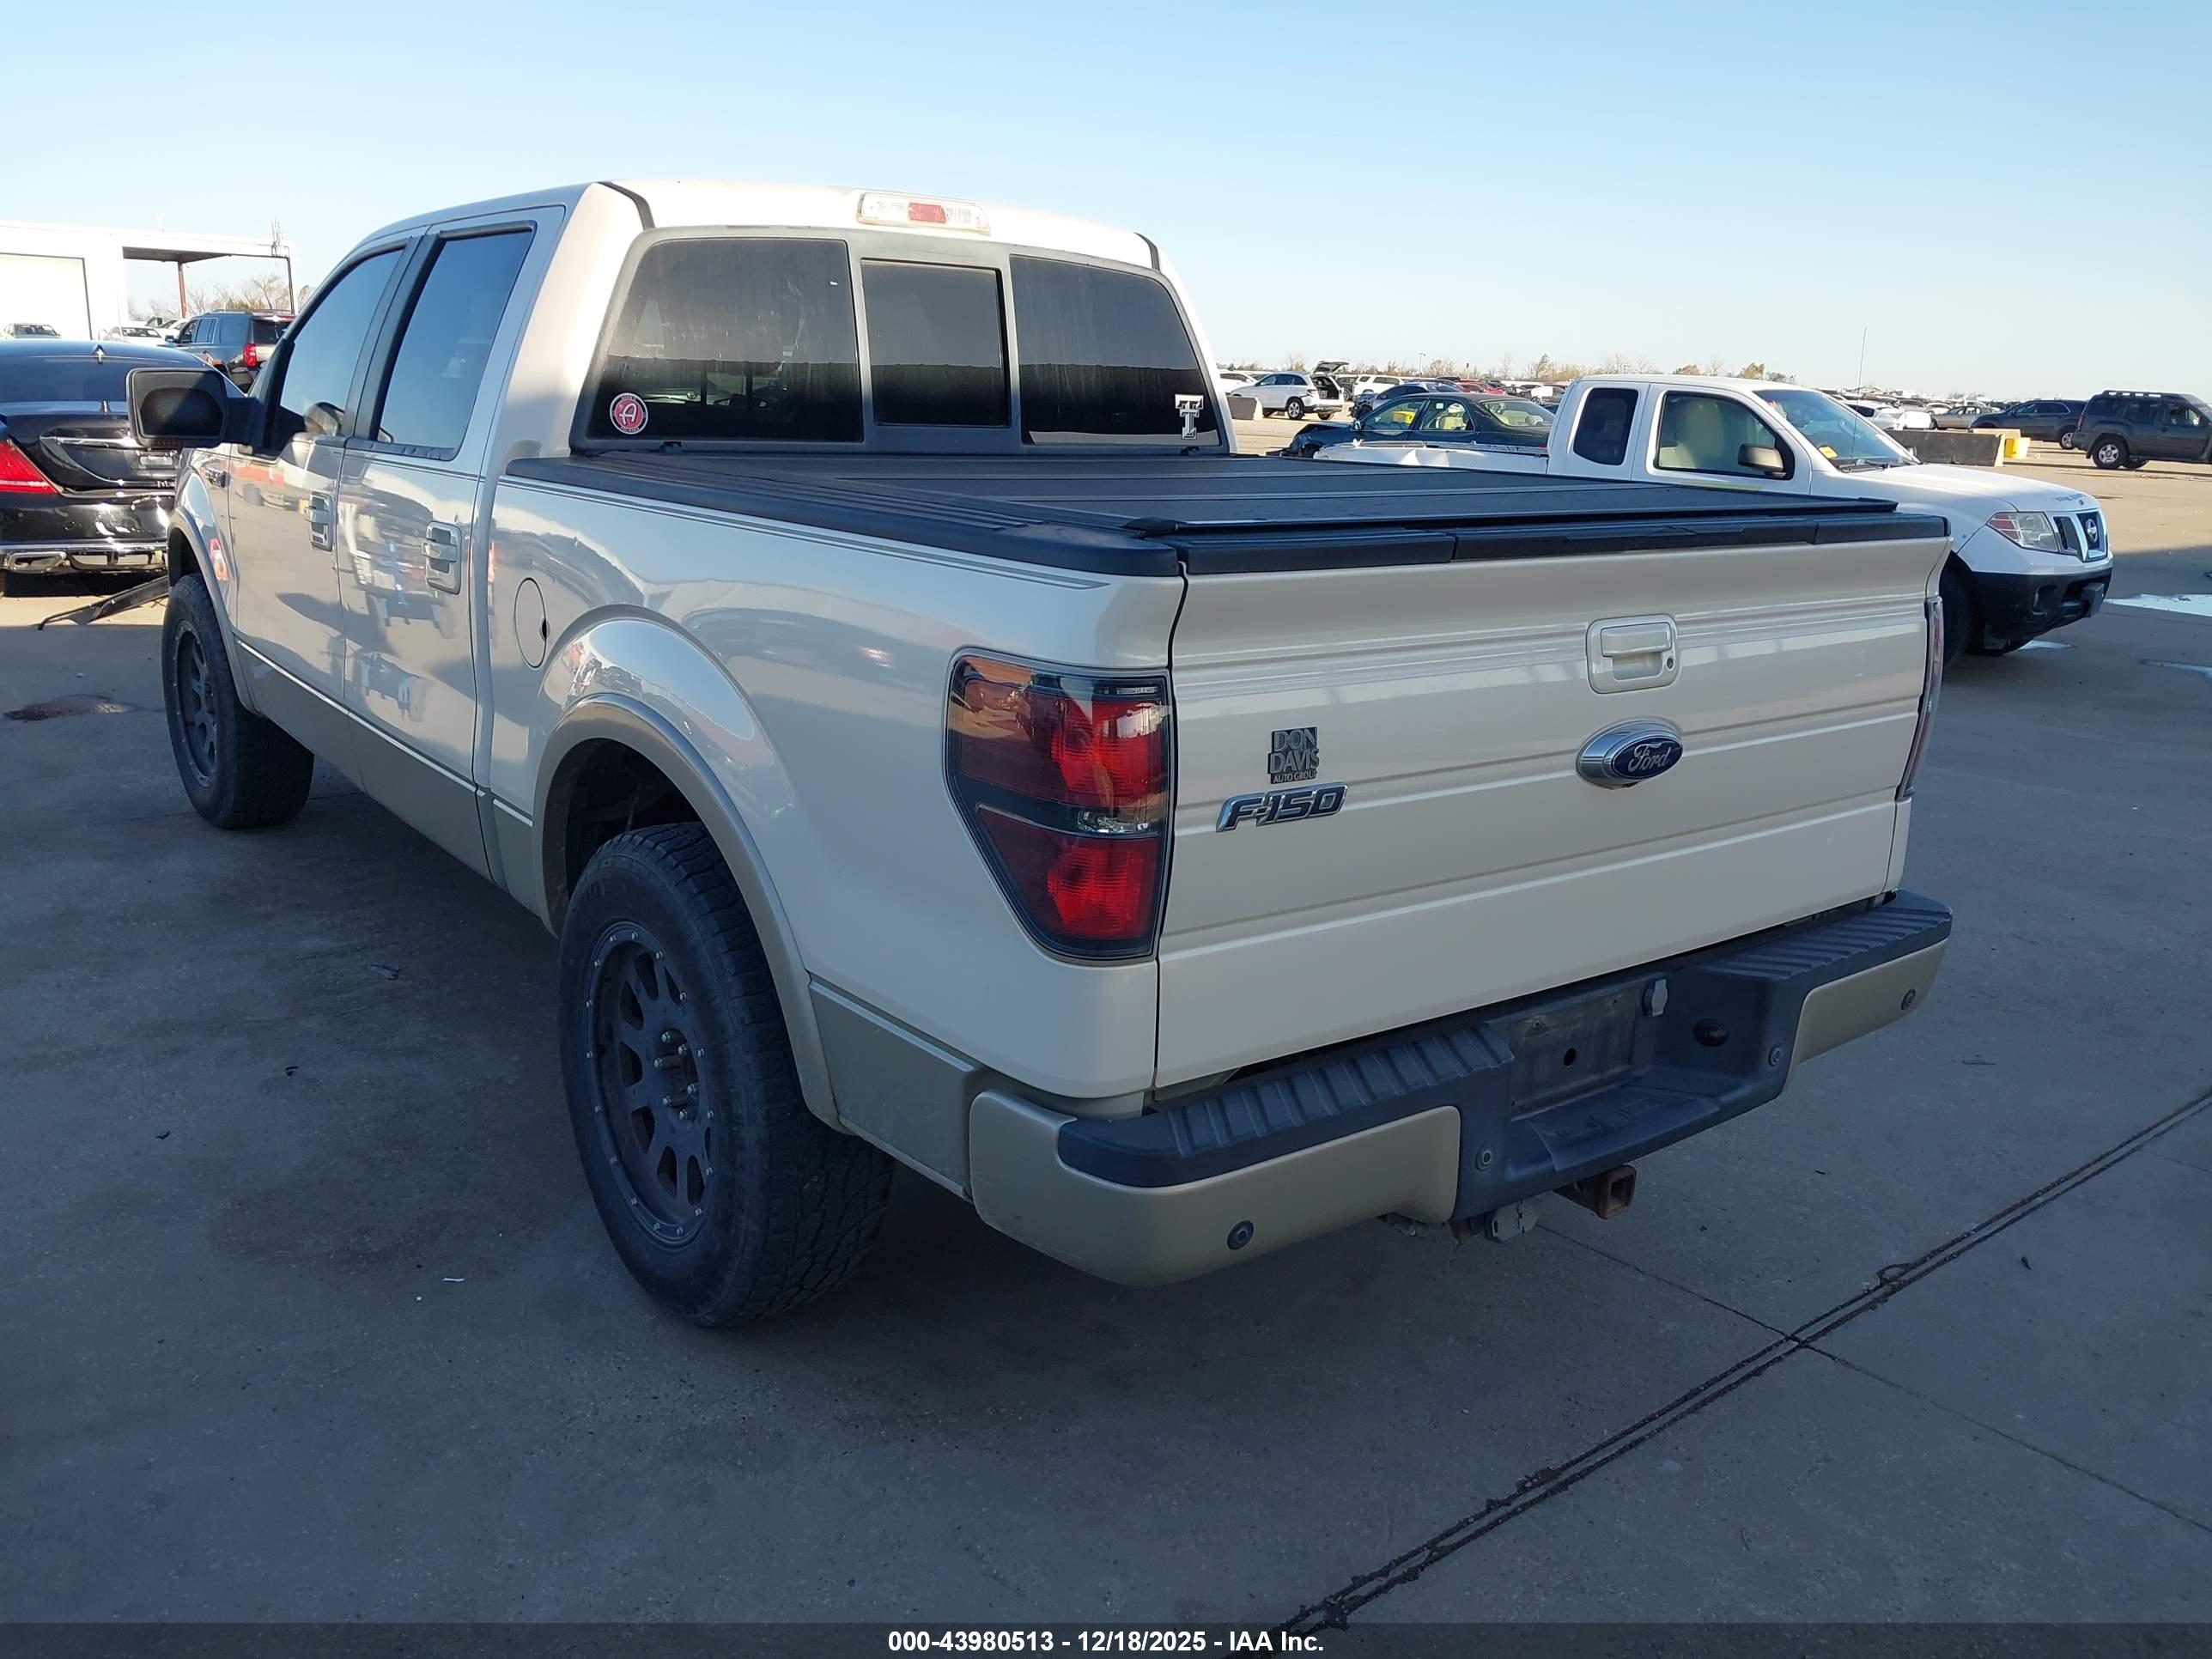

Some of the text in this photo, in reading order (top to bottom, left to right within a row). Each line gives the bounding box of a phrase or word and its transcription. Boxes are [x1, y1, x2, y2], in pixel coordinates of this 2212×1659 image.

[1273, 728, 1317, 751] DON
[1269, 748, 1320, 774] DAVIS
[1628, 742, 1671, 773] Ford
[1272, 772, 1293, 784] AUTO
[1216, 782, 1348, 833] F-150
